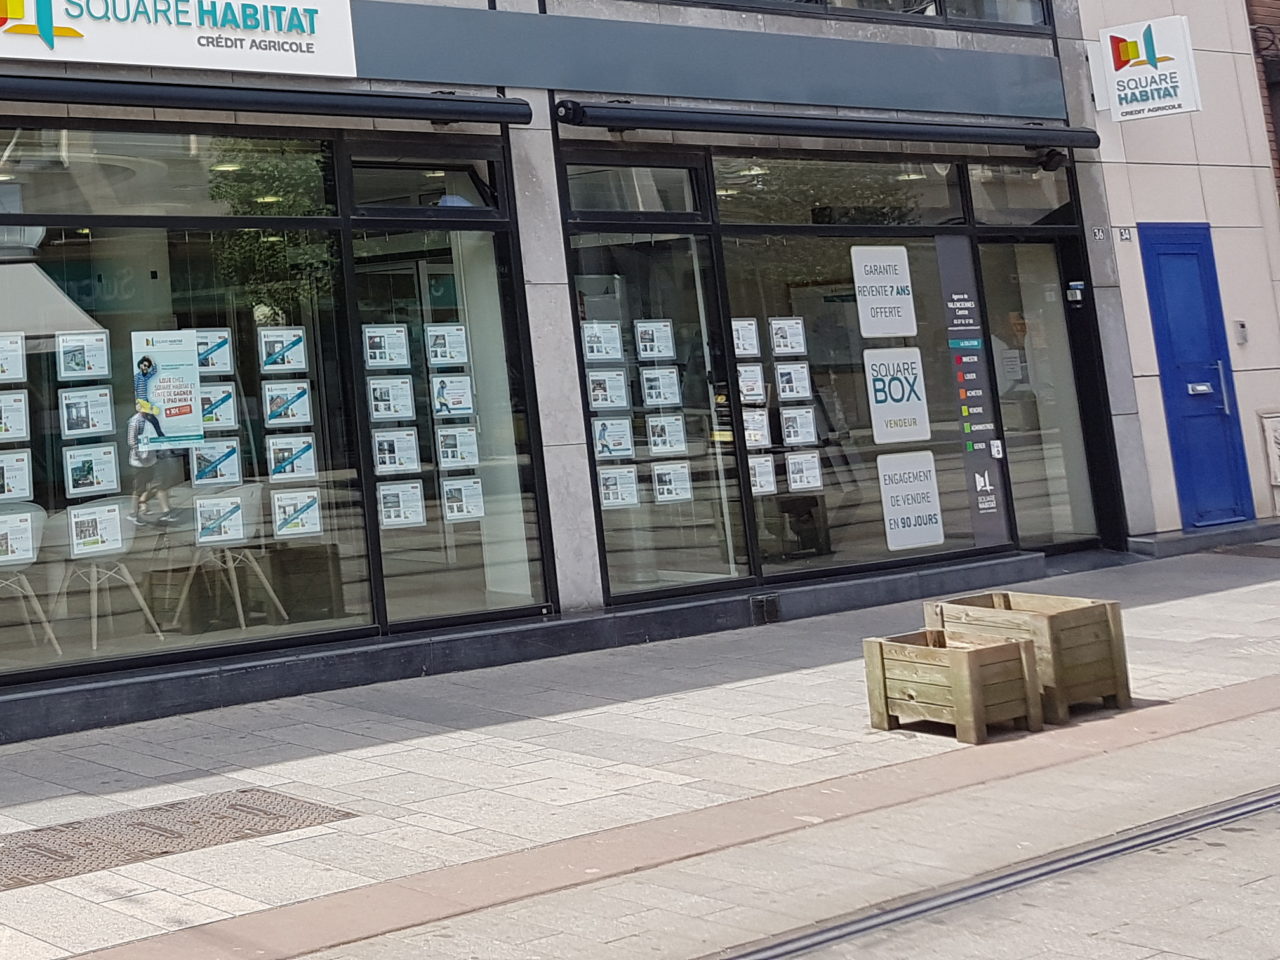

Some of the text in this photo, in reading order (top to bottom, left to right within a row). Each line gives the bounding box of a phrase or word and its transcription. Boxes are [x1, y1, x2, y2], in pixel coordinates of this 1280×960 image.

[196, 0, 319, 36] HABITAT
[196, 34, 316, 54] CRÉDIT AGRICOLE
[1116, 71, 1179, 92] SQUARE
[1117, 84, 1180, 106] HABITAT
[1147, 103, 1183, 114] AGRICOLE
[1093, 228, 1105, 240] 36
[863, 264, 900, 276] GARANTIE
[857, 285, 911, 297] REVENTE 7 ANS
[870, 306, 902, 318] OFFERTE
[870, 361, 918, 378] SQUARE
[871, 375, 922, 404] BOX
[884, 417, 918, 429] VENDEUR
[883, 469, 932, 486] ENGAGEMENT
[890, 491, 932, 507] DE VENDRE
[888, 513, 939, 530] EN 90 JOURS
